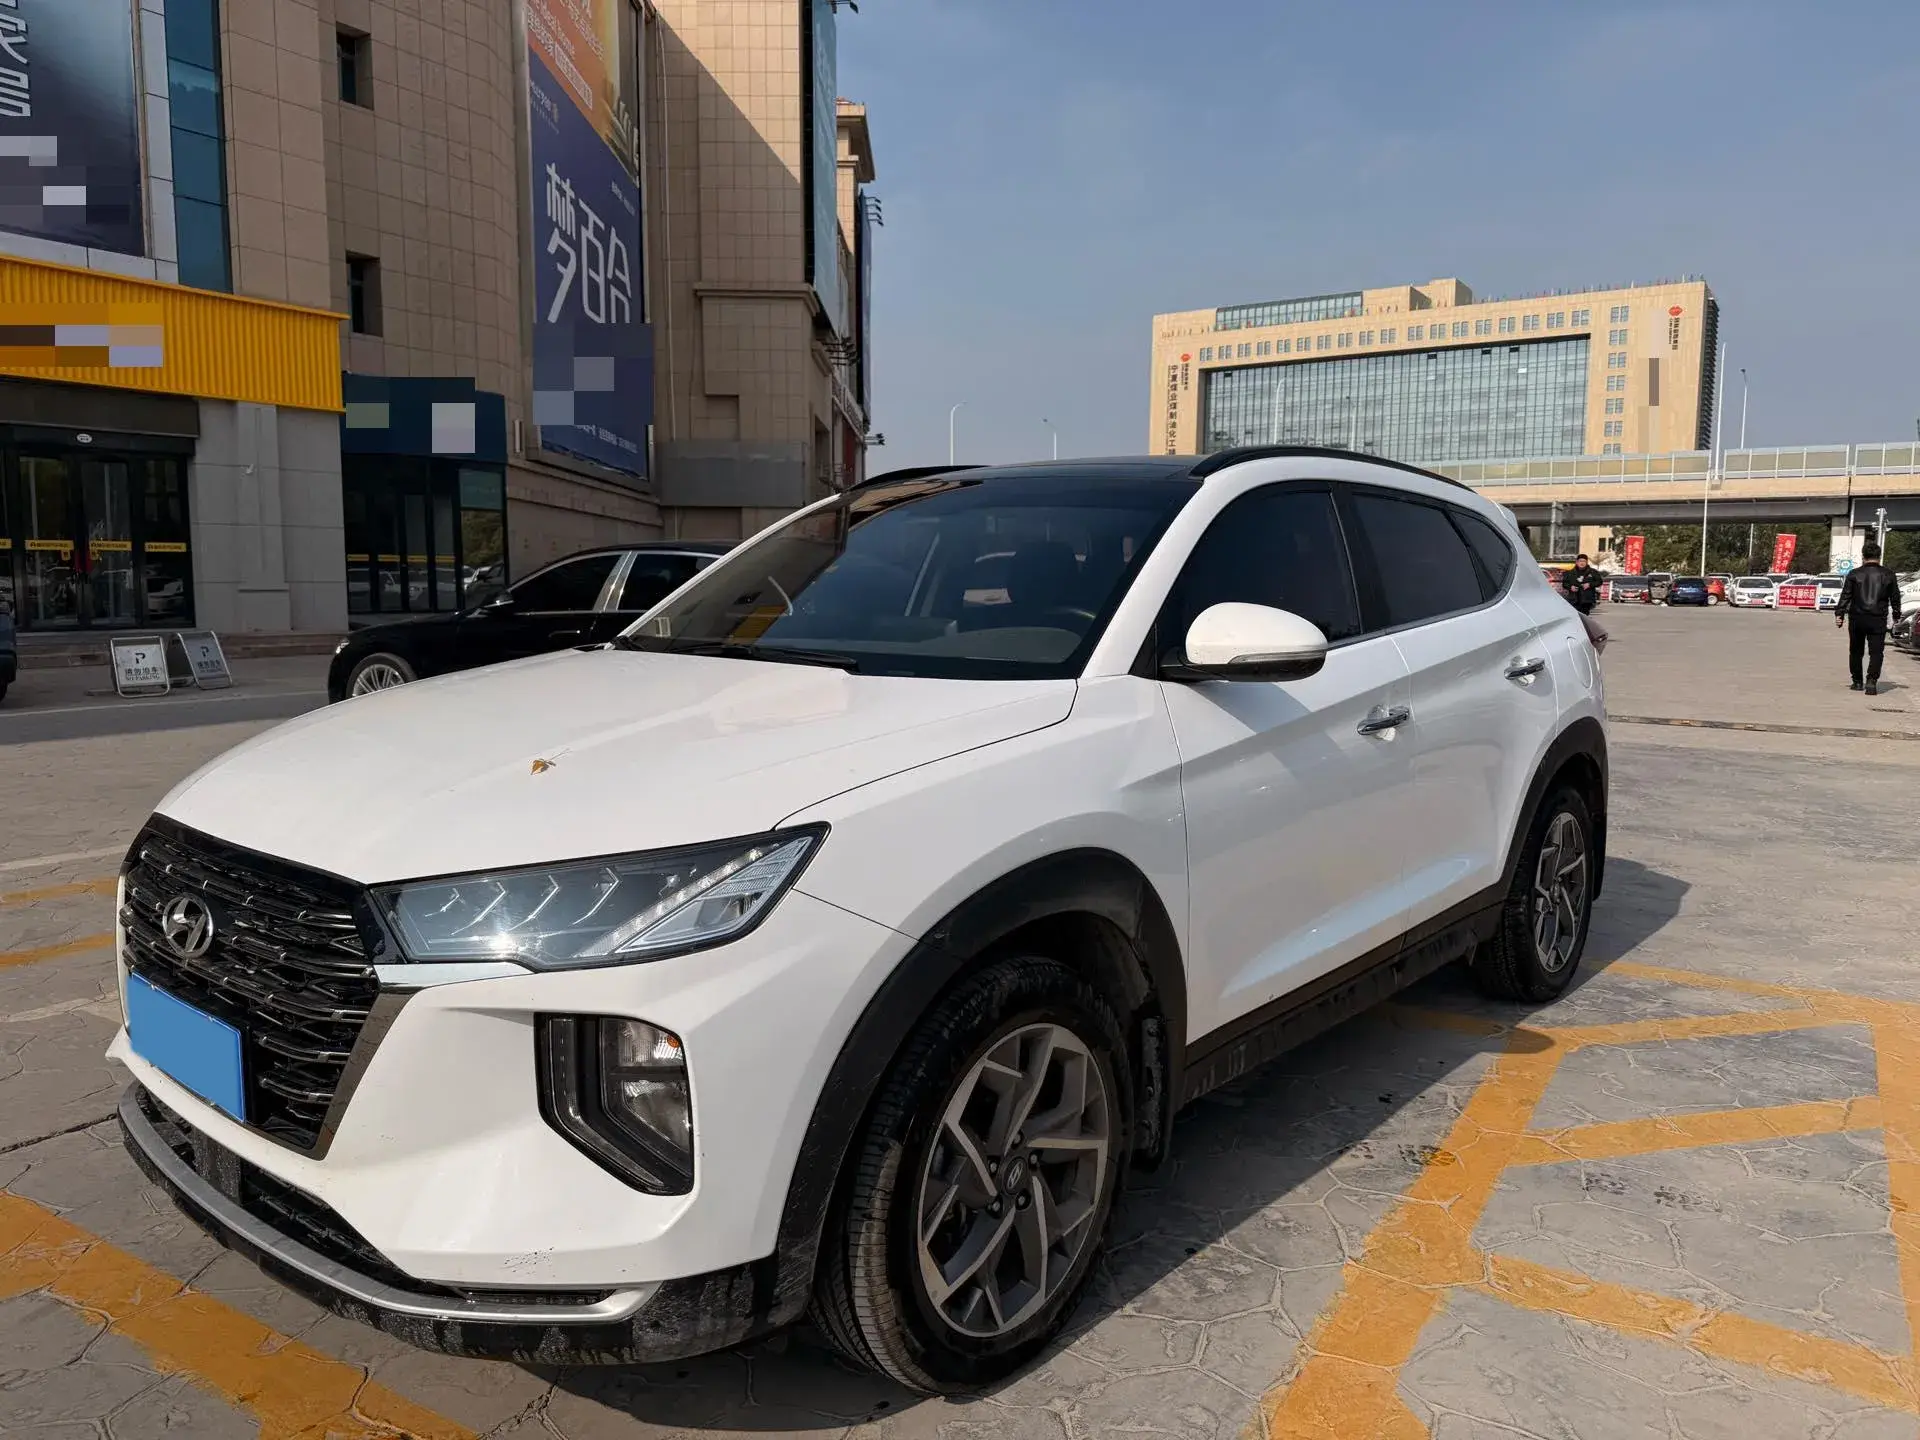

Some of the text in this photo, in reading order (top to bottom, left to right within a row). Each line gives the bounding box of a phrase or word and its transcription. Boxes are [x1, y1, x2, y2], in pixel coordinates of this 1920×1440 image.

[1780, 587, 1816, 599] 二手车展示区
[125, 666, 159, 675] 请勿泊车
